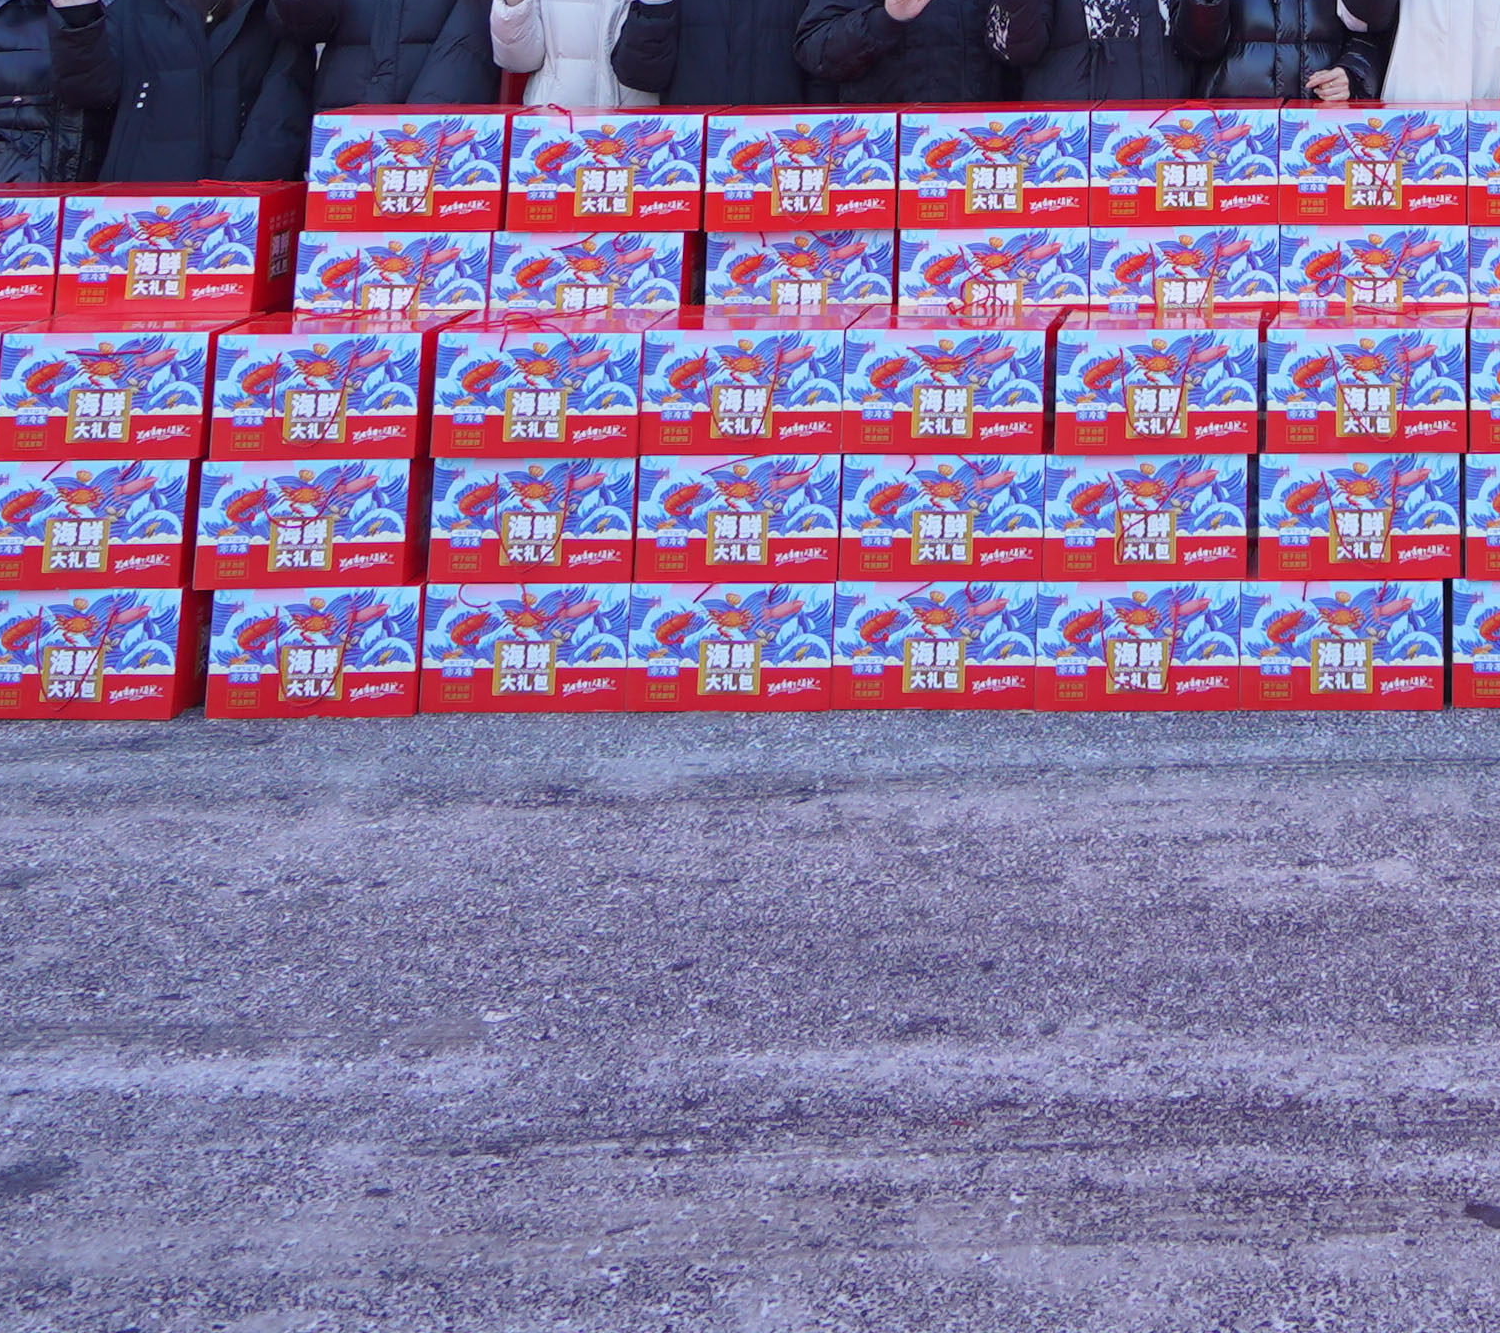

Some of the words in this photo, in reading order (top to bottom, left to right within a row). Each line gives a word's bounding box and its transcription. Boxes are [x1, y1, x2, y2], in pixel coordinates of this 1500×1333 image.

[582, 170, 628, 192] 海鲜
[779, 169, 823, 191] 海鲜
[972, 167, 1017, 188] 海鲜
[1163, 165, 1207, 186] 海鲜
[581, 198, 627, 213] 大礼包
[780, 197, 822, 212] 大礼包
[972, 193, 1017, 208] 大礼包
[1164, 191, 1206, 206] 大礼包
[134, 252, 182, 274] 海鲜
[133, 280, 179, 295] 大礼包
[76, 392, 126, 416] 海鲜
[511, 392, 561, 416] 海鲜
[919, 388, 967, 412] 海鲜
[1133, 388, 1180, 412] 海鲜
[74, 421, 123, 438] 大礼包
[510, 421, 559, 438] 大礼包
[919, 417, 966, 434] 大礼包
[1134, 417, 1180, 434] 大礼包
[276, 520, 329, 545] 海鲜
[508, 515, 556, 539] 海鲜
[714, 515, 762, 539] 海鲜
[919, 514, 967, 538] 海鲜
[1122, 514, 1169, 538] 海鲜
[1336, 512, 1383, 536] 海鲜
[51, 522, 104, 546] 海鲜
[274, 550, 326, 567] 大礼包
[508, 544, 555, 561] 大礼包
[714, 544, 761, 561] 大礼包
[919, 543, 966, 560] 大礼包
[1123, 543, 1169, 560] 大礼包
[1337, 541, 1383, 558] 大礼包
[49, 551, 101, 568] 大礼包
[288, 649, 337, 674] 海鲜
[501, 644, 549, 669] 海鲜
[706, 644, 754, 668] 海鲜
[910, 642, 960, 666] 海鲜
[1318, 642, 1365, 667] 海鲜
[287, 680, 335, 697] 大礼包
[501, 674, 548, 691] 大礼包
[706, 673, 753, 690] 大礼包
[909, 671, 958, 688] 大礼包
[1319, 672, 1365, 689] 大礼包
